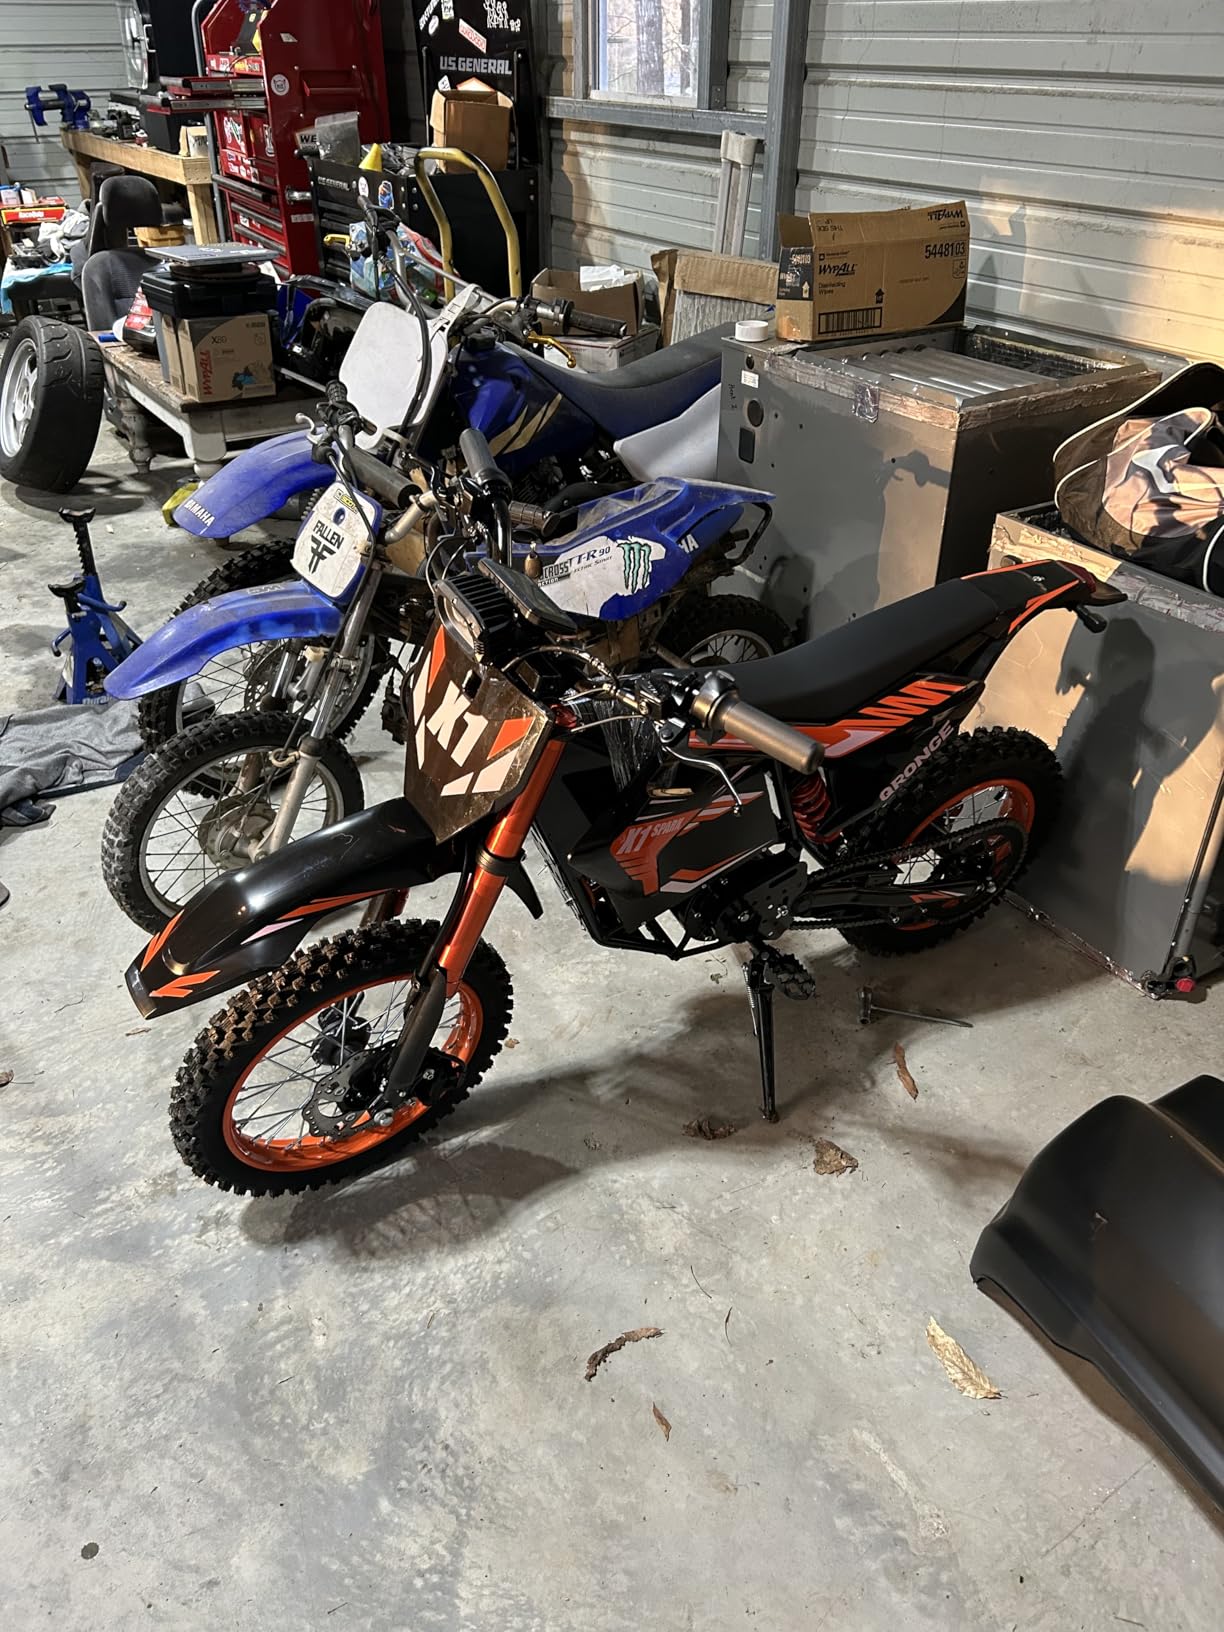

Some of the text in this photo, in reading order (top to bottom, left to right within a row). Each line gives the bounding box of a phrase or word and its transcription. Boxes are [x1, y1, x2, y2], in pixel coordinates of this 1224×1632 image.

[457, 57, 512, 75] GENERAL
[925, 242, 965, 259] 5448103
[819, 262, 856, 277] WYPALL
[312, 520, 345, 550] FALLEN
[598, 546, 611, 557] 90
[541, 560, 569, 579] CROSS
[426, 680, 489, 767] X1
[879, 720, 954, 801] QRONGE
[616, 817, 685, 855] X1 SPARK
